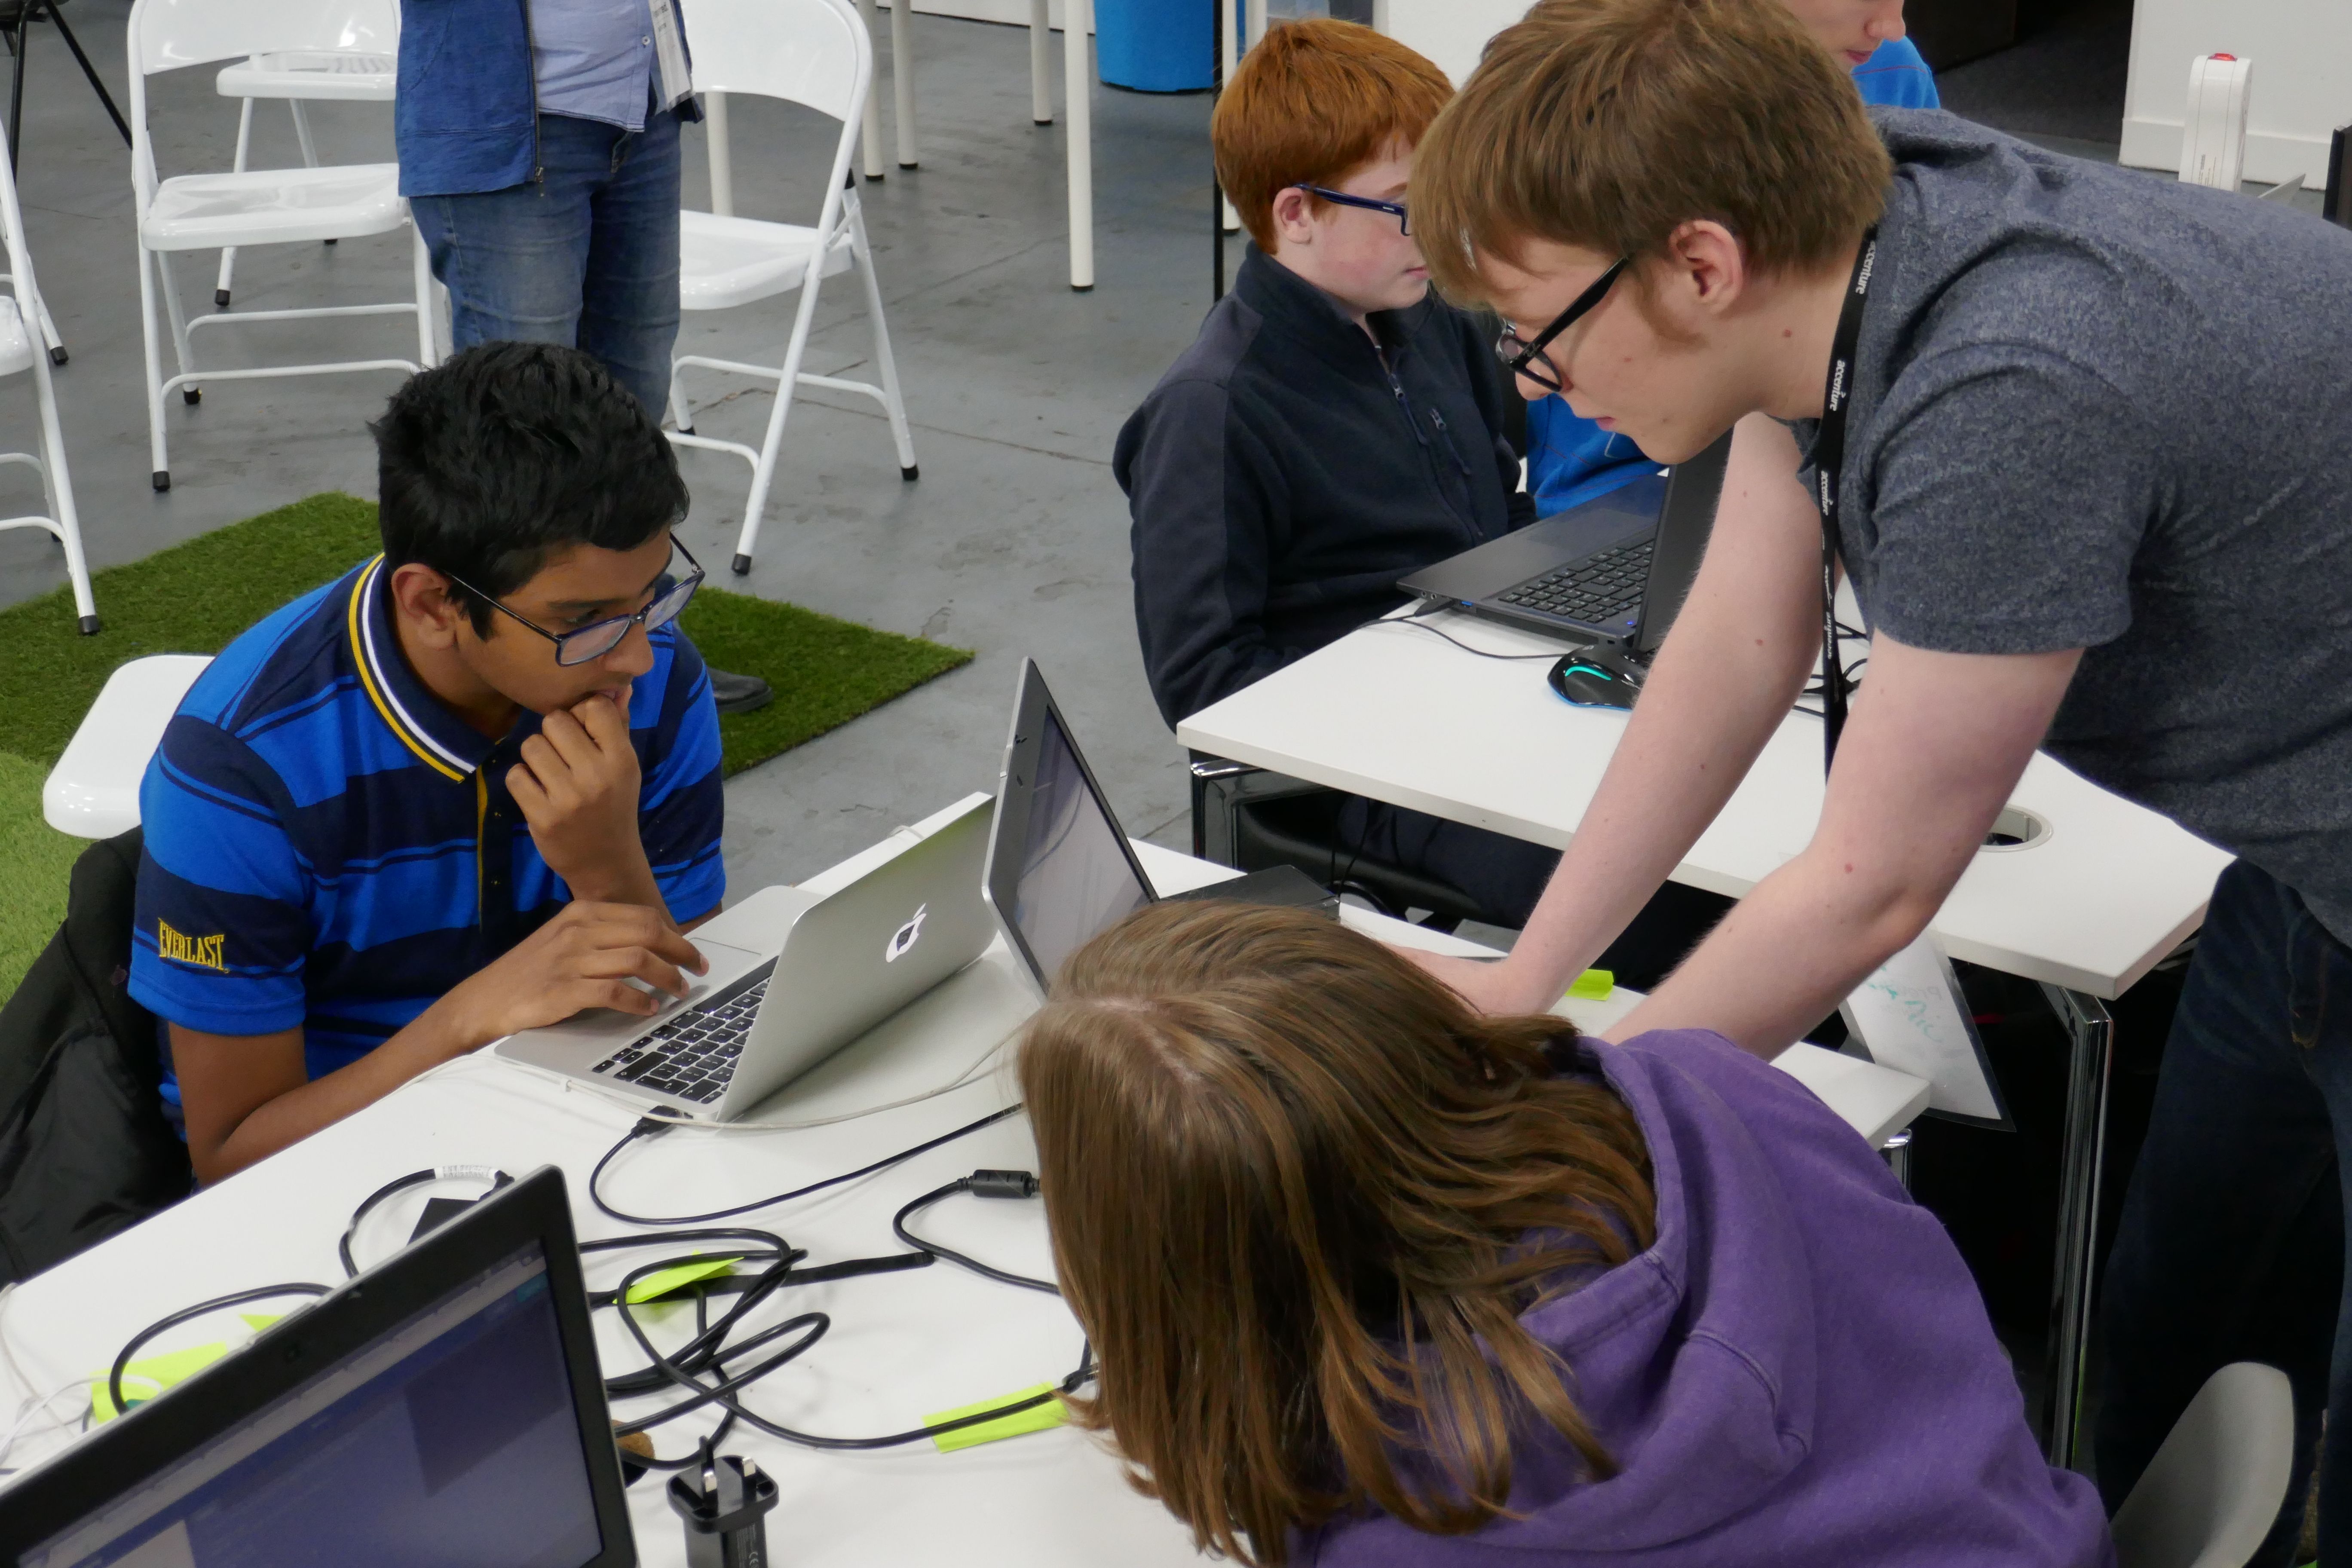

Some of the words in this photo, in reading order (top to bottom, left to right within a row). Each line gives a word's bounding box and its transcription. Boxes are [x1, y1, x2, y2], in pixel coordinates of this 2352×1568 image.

[1855, 240, 1876, 294] accenture
[1829, 359, 1847, 411] accenture
[1821, 470, 1833, 516] accenture
[157, 917, 225, 971] EVERLAST
